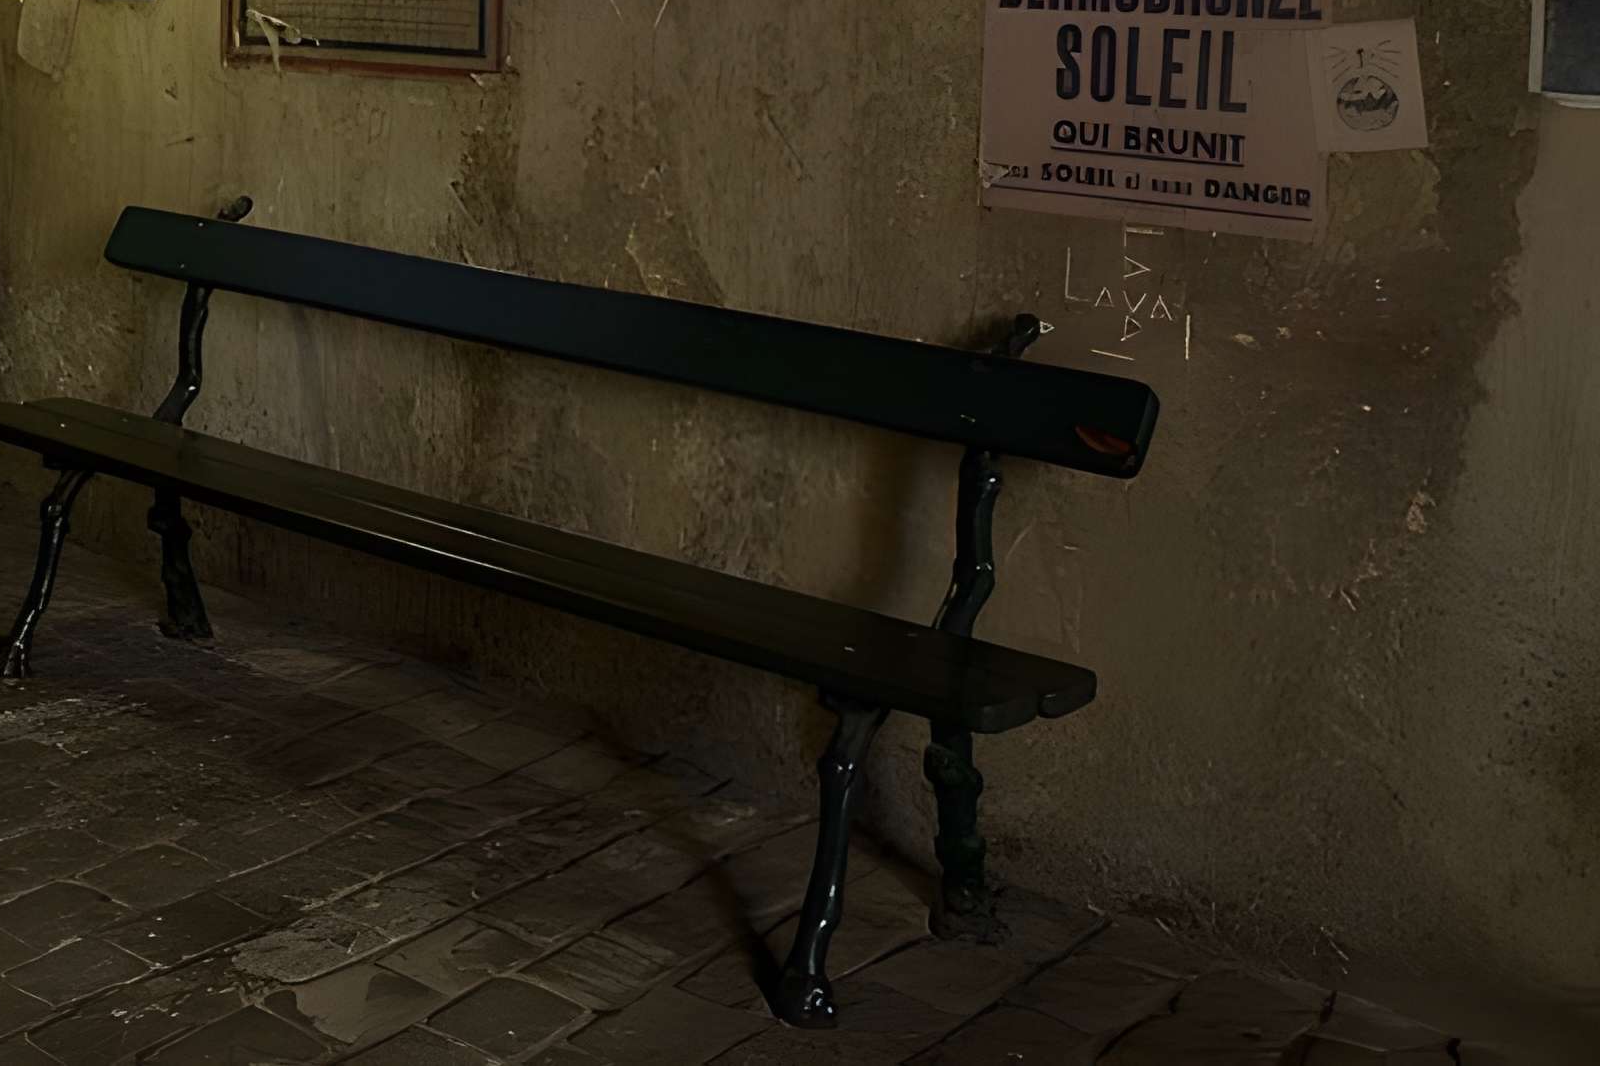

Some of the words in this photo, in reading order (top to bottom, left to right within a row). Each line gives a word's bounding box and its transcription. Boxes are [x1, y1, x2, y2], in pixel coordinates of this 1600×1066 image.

[1055, 23, 1248, 113] SOLEIL
[1052, 119, 1110, 148] QUI
[1123, 125, 1246, 163] BRUNIT
[1203, 178, 1314, 208] DANGER
